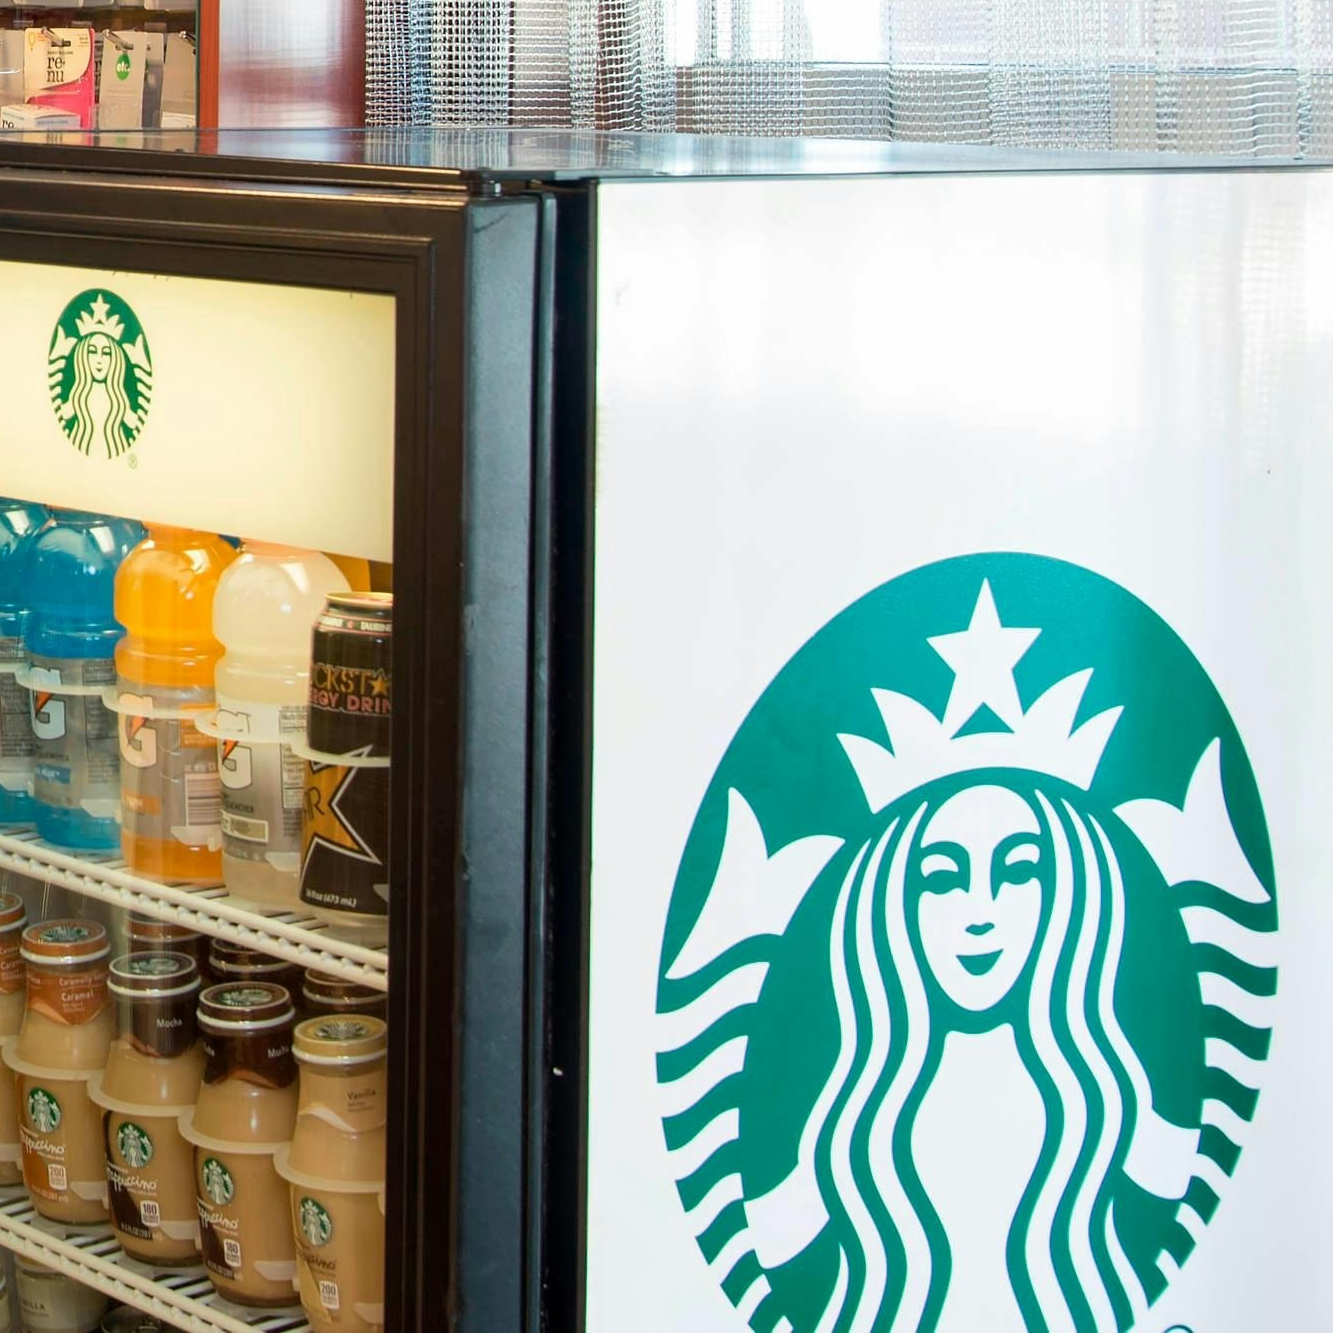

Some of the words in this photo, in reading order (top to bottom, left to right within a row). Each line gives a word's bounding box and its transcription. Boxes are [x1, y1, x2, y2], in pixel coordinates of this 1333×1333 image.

[47, 70, 64, 83] nu
[61, 992, 94, 1001] Caramel
[156, 1018, 182, 1027] Mocha
[347, 1089, 376, 1100] Vanilla
